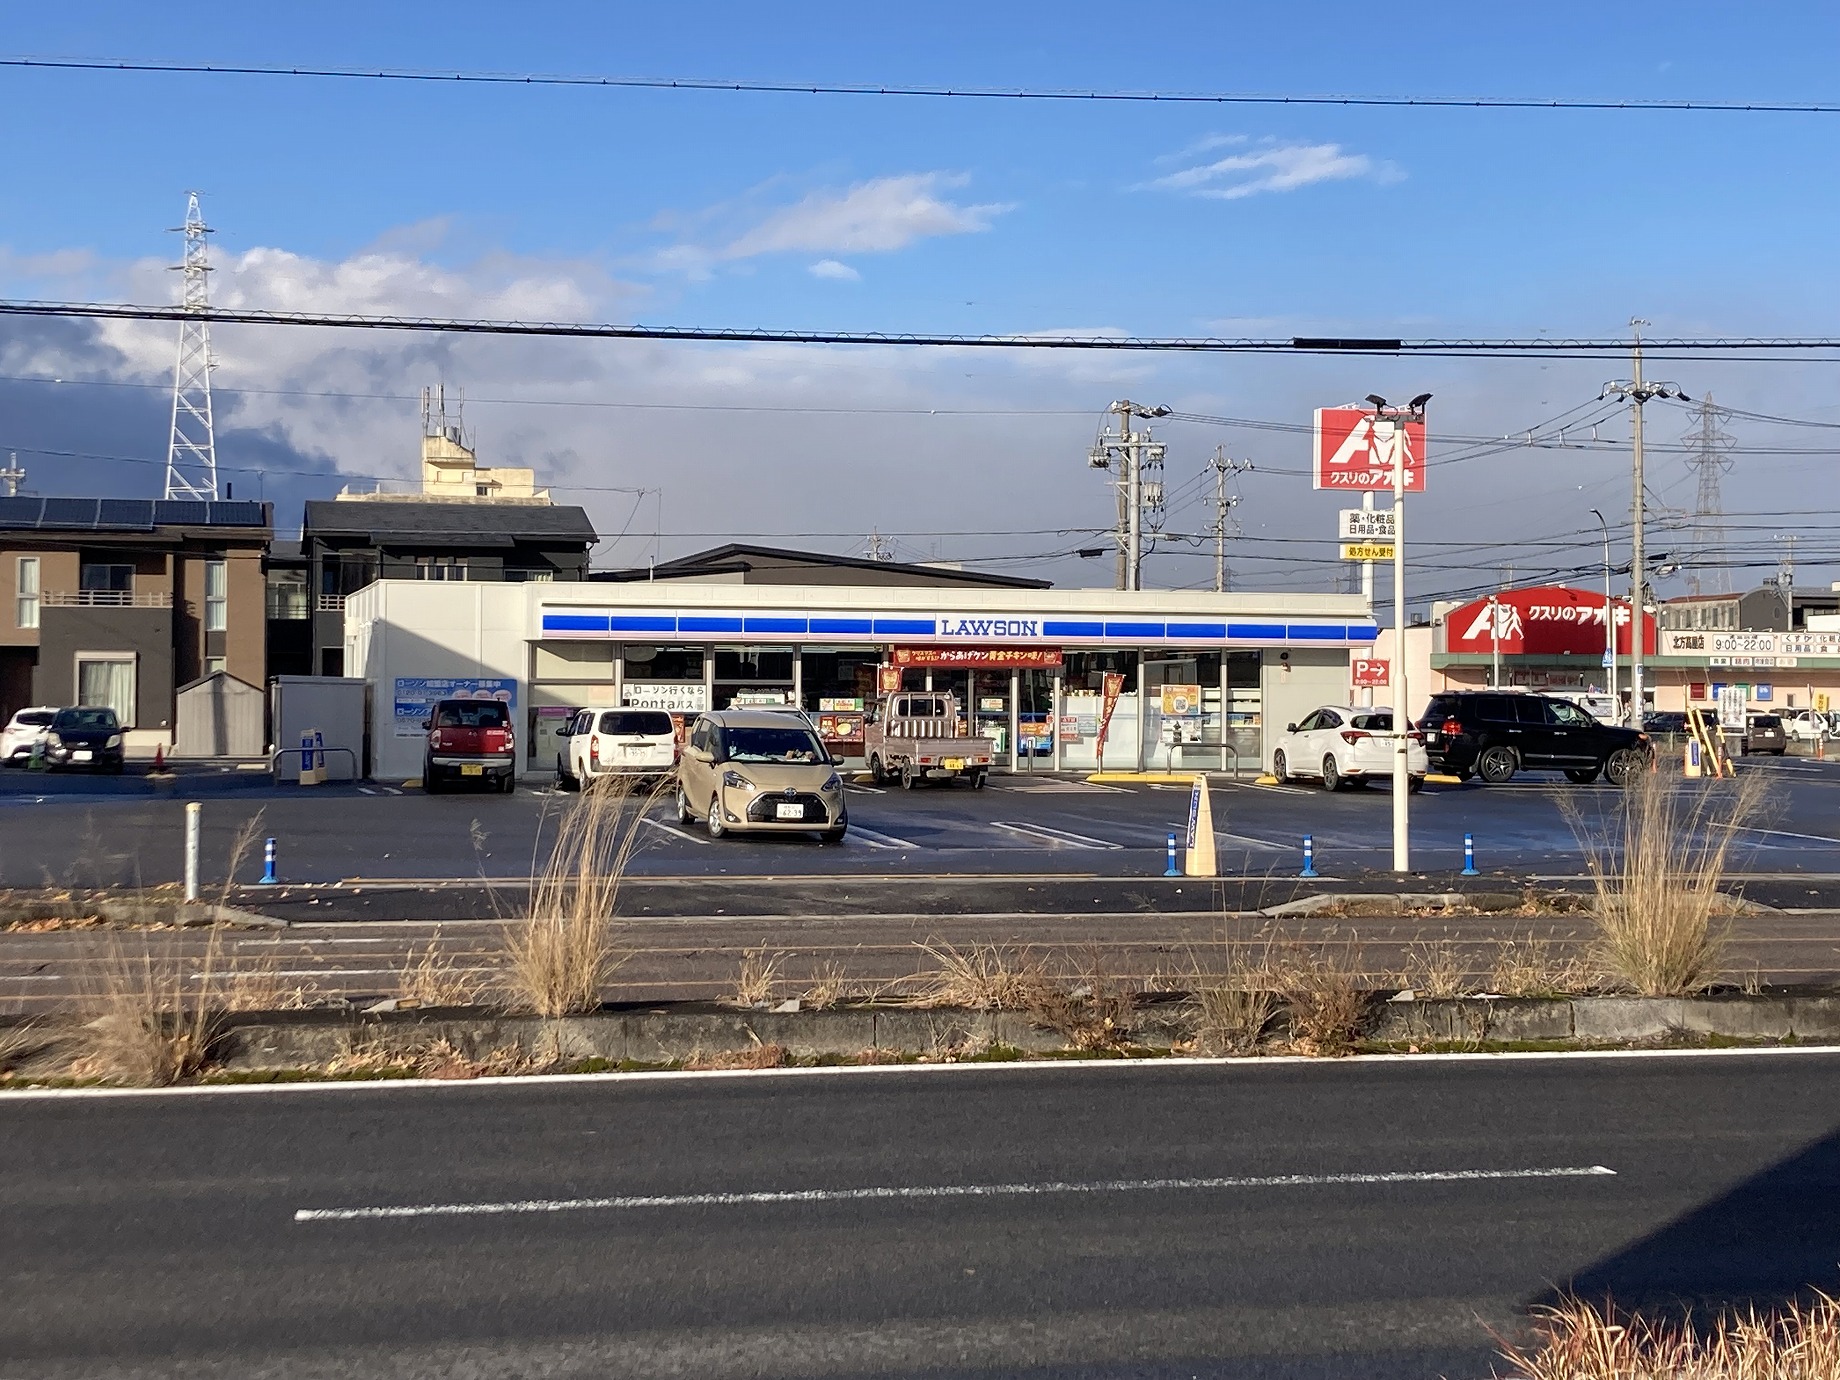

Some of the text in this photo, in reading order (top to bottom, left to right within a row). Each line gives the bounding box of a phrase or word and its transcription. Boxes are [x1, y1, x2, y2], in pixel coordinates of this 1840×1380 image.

[1350, 513, 1395, 525] 薬・化粧品
[1350, 525, 1396, 535] 日用品・食品
[1348, 547, 1393, 557] 処方せん受付
[941, 620, 1038, 636] LAWSON
[1819, 634, 1840, 645] 化粧
[1356, 661, 1369, 678] P
[634, 686, 704, 695] ローソン行くなら
[631, 699, 694, 710] Pontaパス
